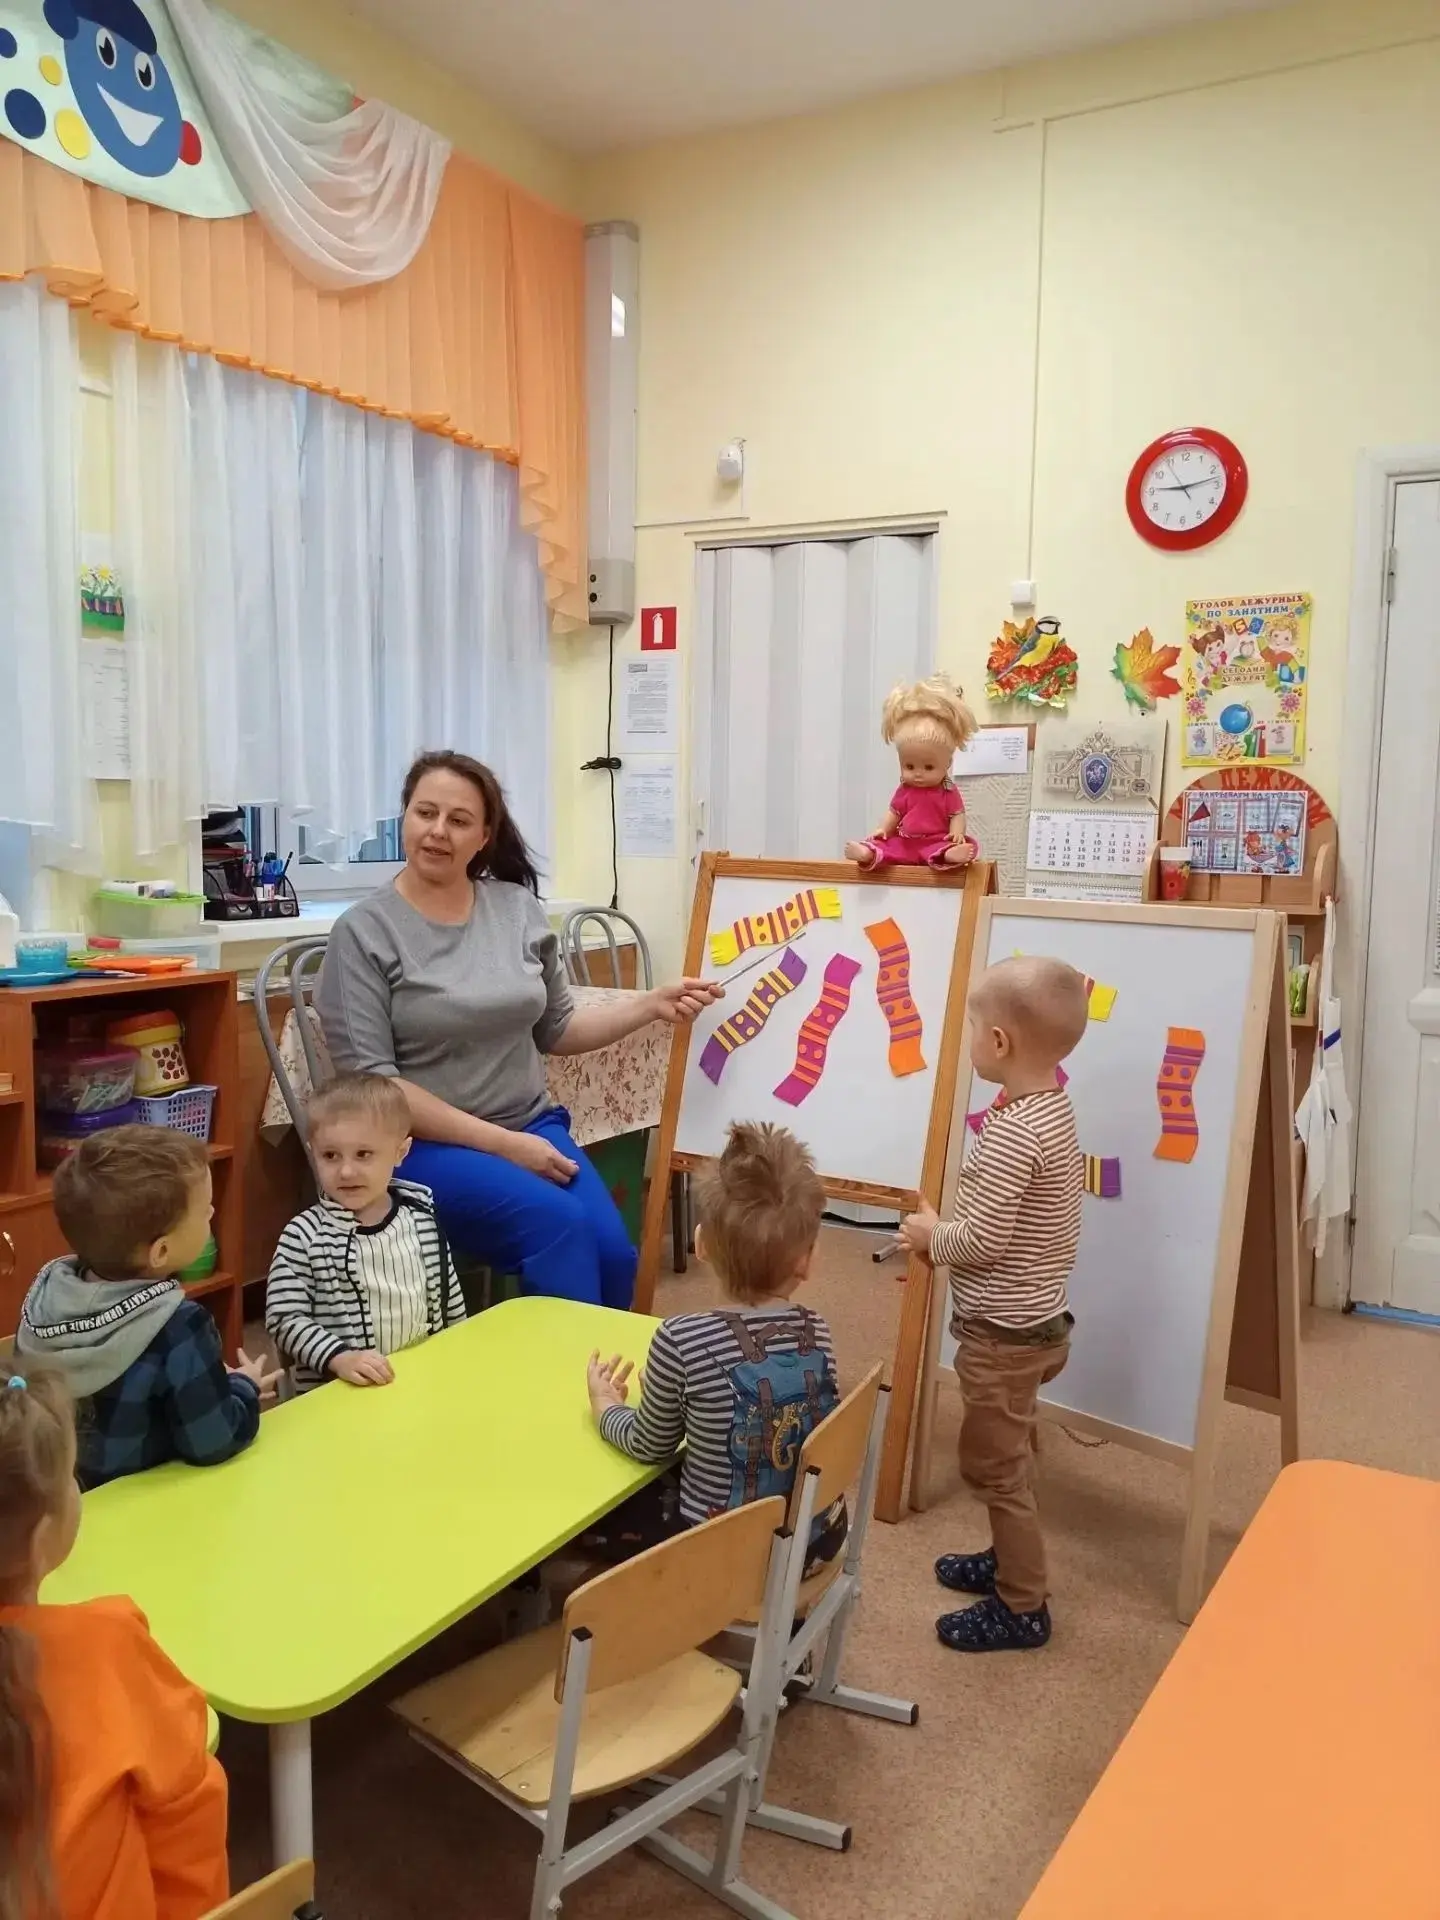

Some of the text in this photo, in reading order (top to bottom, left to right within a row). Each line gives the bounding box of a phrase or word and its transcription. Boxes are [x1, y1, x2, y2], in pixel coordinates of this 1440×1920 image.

[1181, 452, 1191, 462] 12
[1199, 455, 1205, 464] 1
[1155, 471, 1165, 479] 10
[1210, 465, 1217, 475] 2
[1214, 481, 1221, 490] 3
[1149, 487, 1155, 496] 9
[1208, 497, 1215, 505] 4
[1152, 502, 1159, 511] 8
[1165, 512, 1172, 522] 7
[1196, 510, 1203, 520] 5
[1179, 516, 1186, 525] 6
[1193, 596, 1304, 609] УГОЛОК ДЕЖУРНЫХ
[1207, 606, 1289, 618] ПО ЗАНЯТИЯМ
[1221, 675, 1266, 683] ДЕЖУРЯТ
[123, 1290, 150, 1310] SKATE
[95, 1305, 124, 1326] URBAN
[69, 1317, 96, 1332] SKATE
